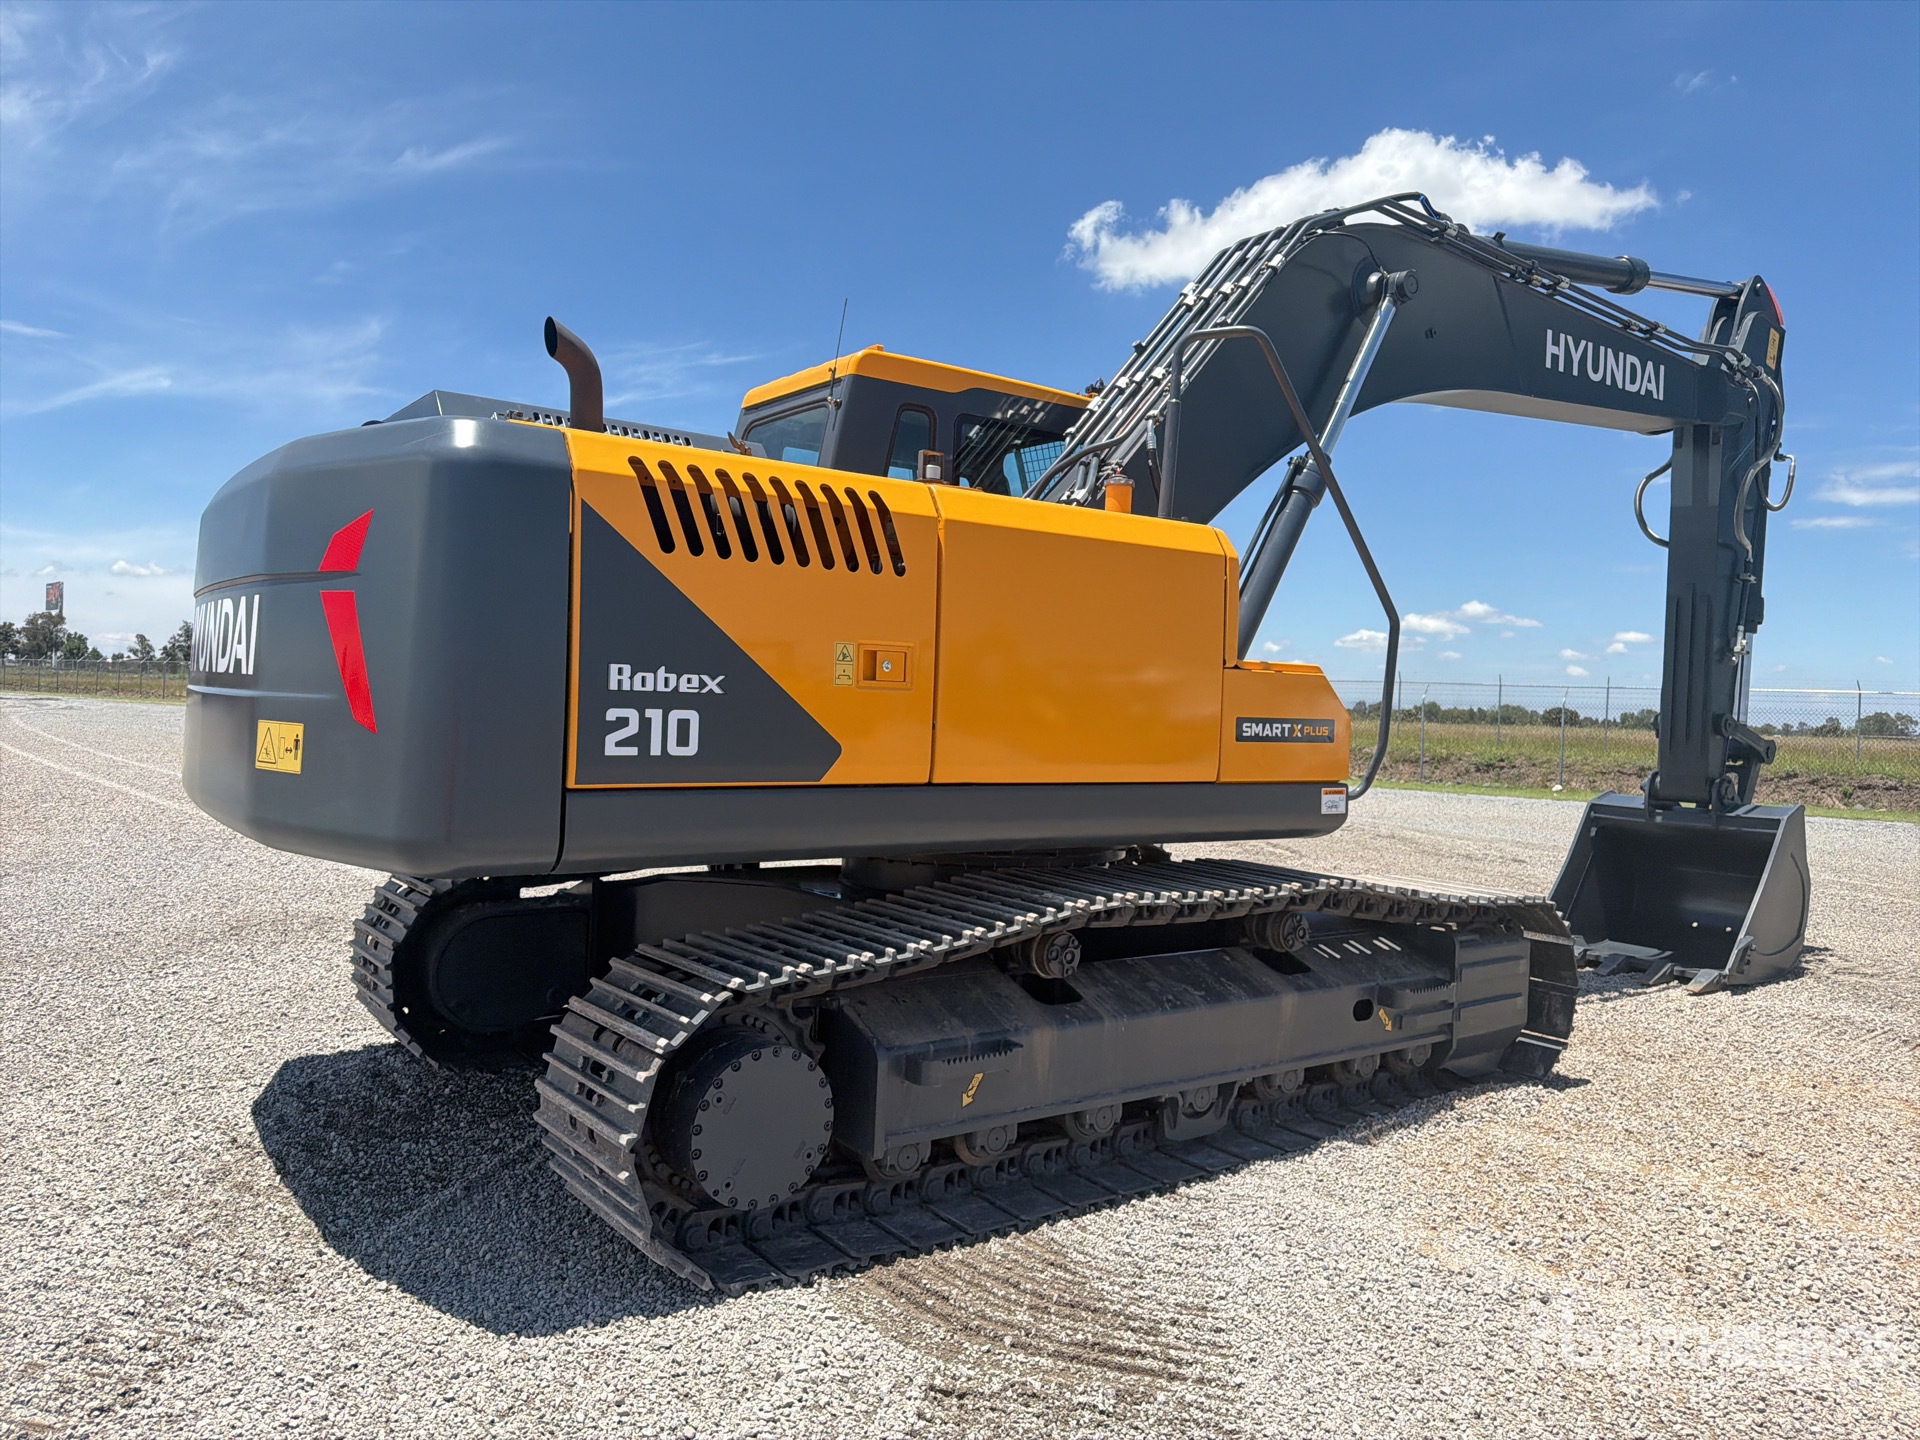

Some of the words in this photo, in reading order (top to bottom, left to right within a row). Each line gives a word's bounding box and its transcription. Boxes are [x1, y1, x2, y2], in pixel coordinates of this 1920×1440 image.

[1545, 328, 1665, 401] HYUNDAI
[608, 663, 725, 694] Robex
[604, 707, 700, 757] 210
[1242, 722, 1292, 738] SMART
[1292, 723, 1303, 738] X
[1303, 725, 1329, 737] PLUS
